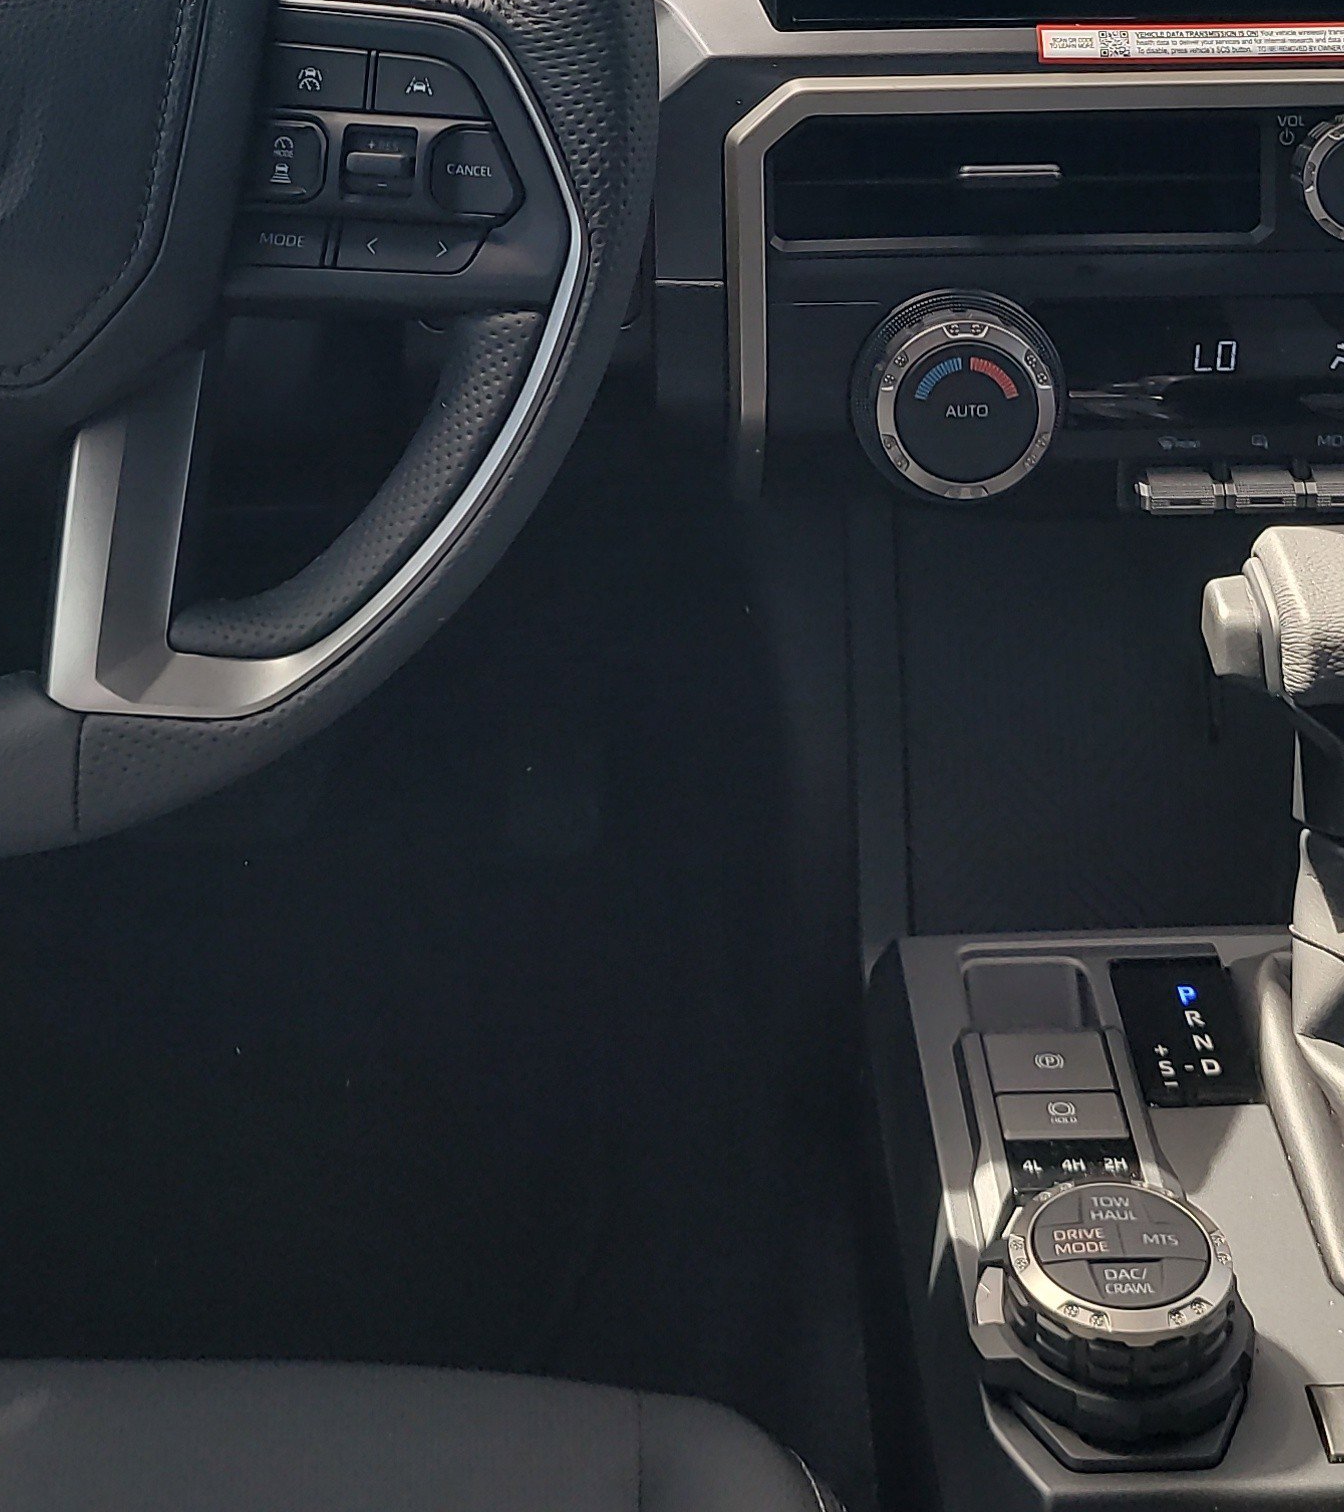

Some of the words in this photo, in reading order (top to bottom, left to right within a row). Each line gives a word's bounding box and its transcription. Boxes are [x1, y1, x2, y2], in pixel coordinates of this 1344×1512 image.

[1277, 115, 1305, 127] VOL
[447, 164, 492, 177] CANCEL
[259, 232, 306, 247] MODE
[1193, 341, 1237, 373] LO
[946, 404, 989, 418] AUTO
[1177, 986, 1199, 1006] P
[1184, 1010, 1206, 1028] R
[1192, 1034, 1215, 1052] N
[1158, 1060, 1176, 1078] S
[1200, 1058, 1223, 1076] D
[1022, 1159, 1044, 1173] 4L
[1062, 1157, 1087, 1172] 4H
[1103, 1157, 1129, 1172] 2H
[1091, 1196, 1131, 1208] TOW
[1090, 1209, 1138, 1222] HAUL
[1053, 1228, 1105, 1241] DRIVE
[1142, 1233, 1179, 1247] MTS
[1055, 1240, 1109, 1255] MODE
[1104, 1268, 1147, 1281] DAC/
[1105, 1282, 1156, 1295] CRAWL
